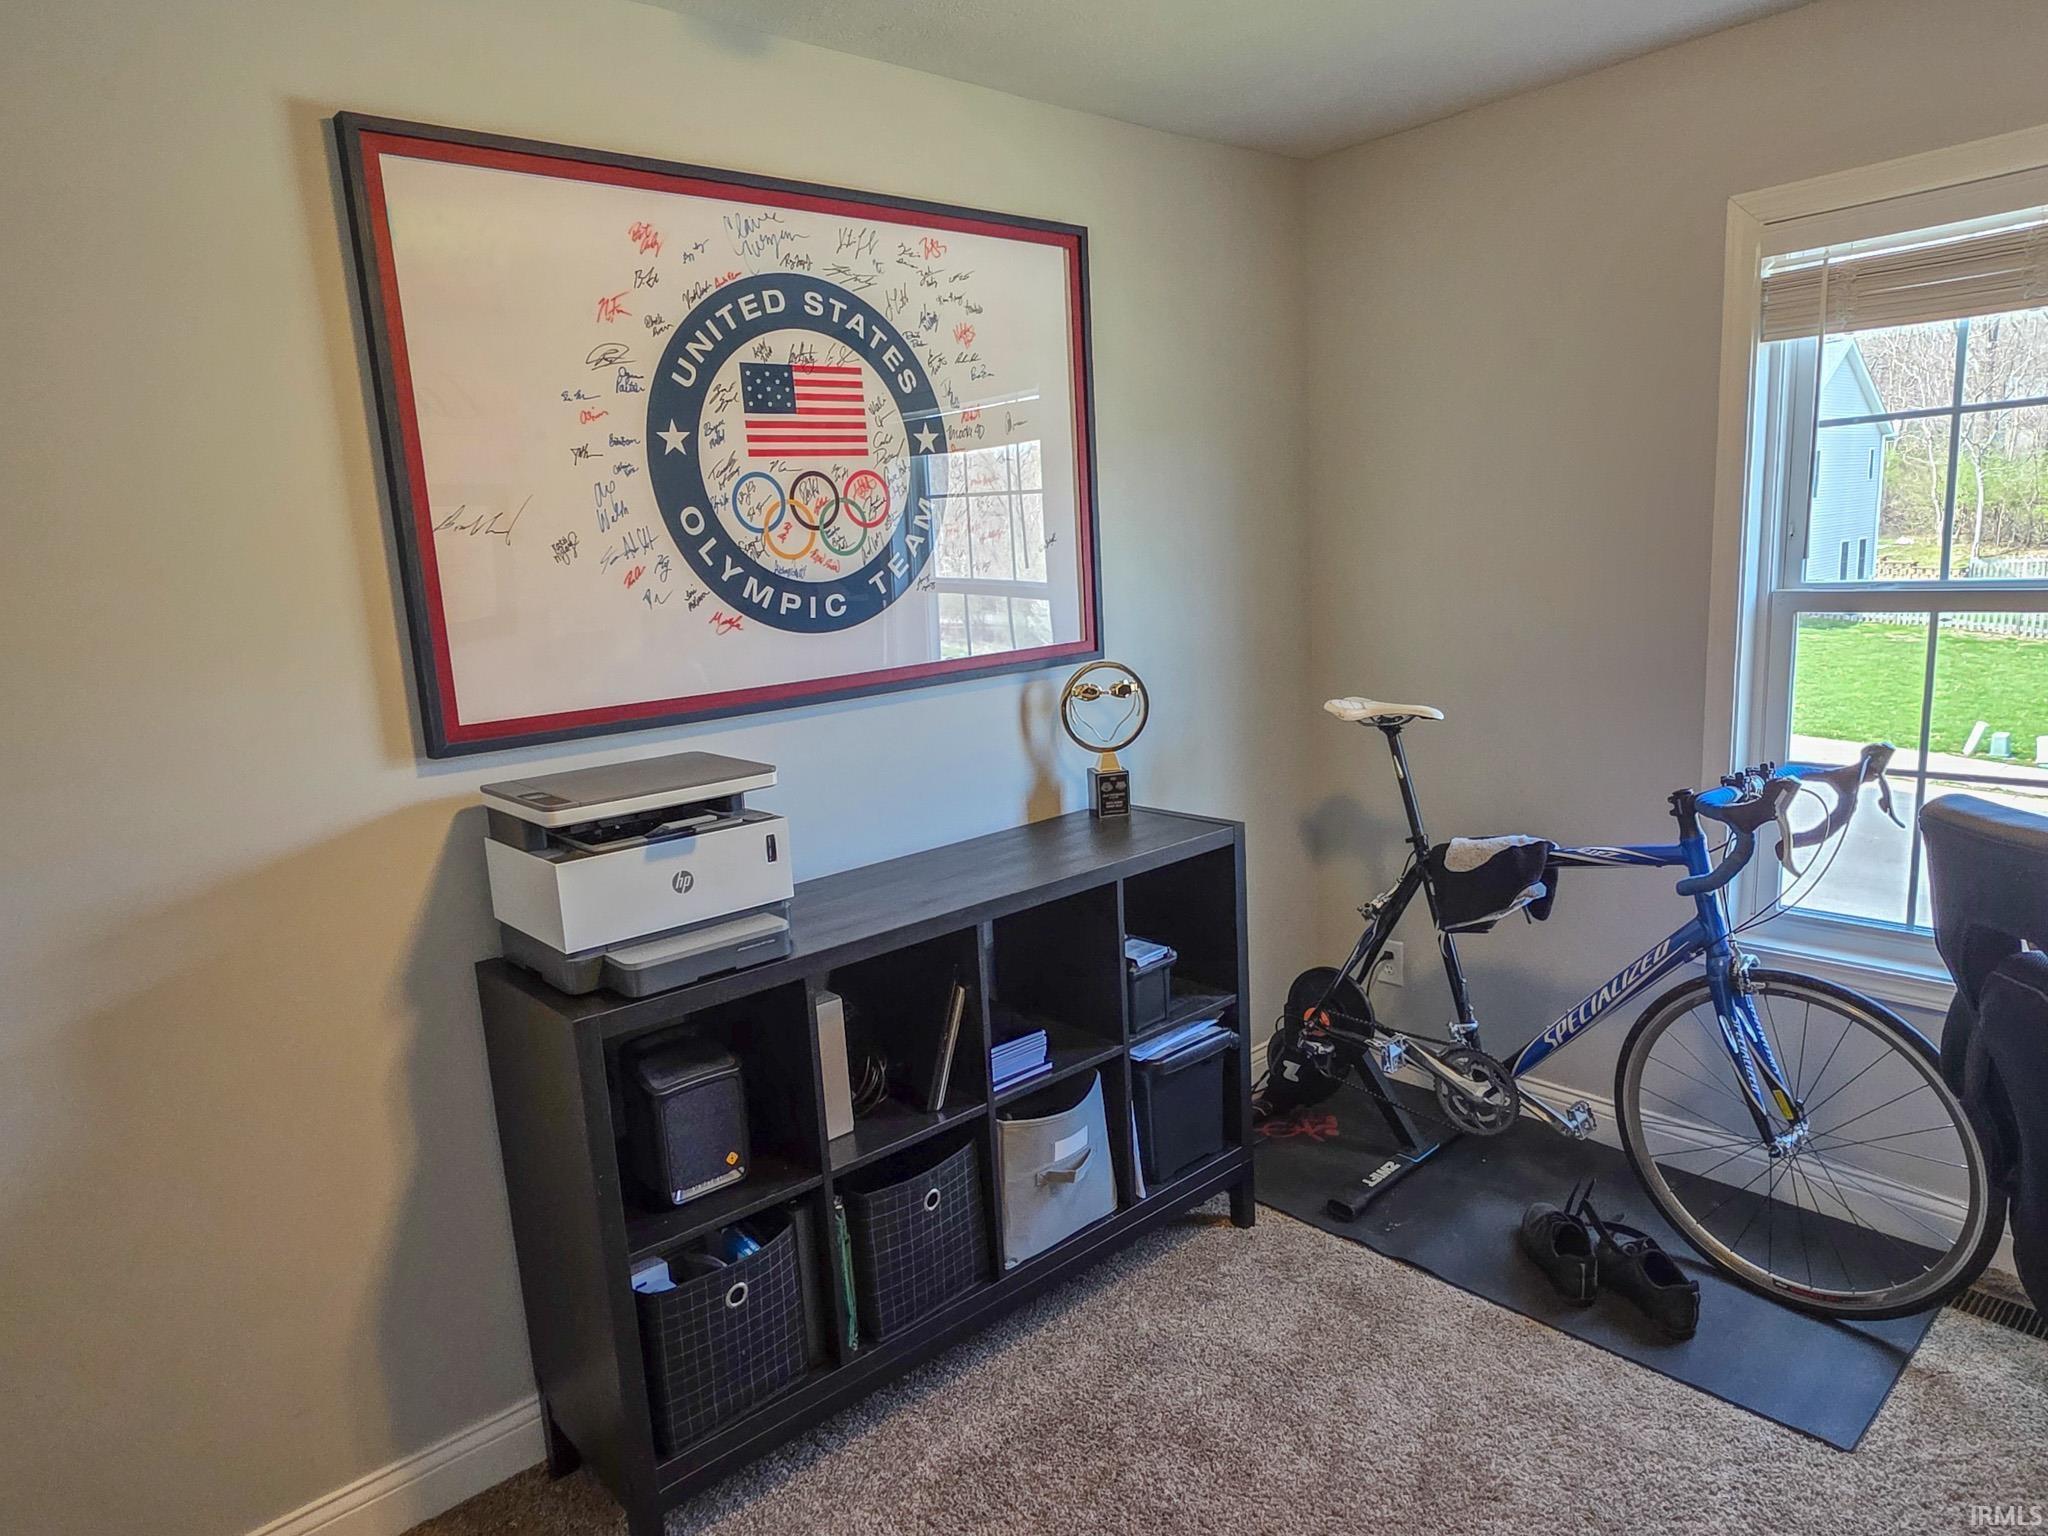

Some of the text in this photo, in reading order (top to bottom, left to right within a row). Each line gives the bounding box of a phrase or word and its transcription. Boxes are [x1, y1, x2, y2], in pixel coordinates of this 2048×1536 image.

[671, 289, 786, 388] UNITED
[803, 291, 917, 394] STATES
[680, 506, 847, 619] OLYMPIC
[868, 497, 933, 595] TEAM
[673, 870, 693, 895] hp
[1543, 939, 1671, 1048] SPECIALIZED
